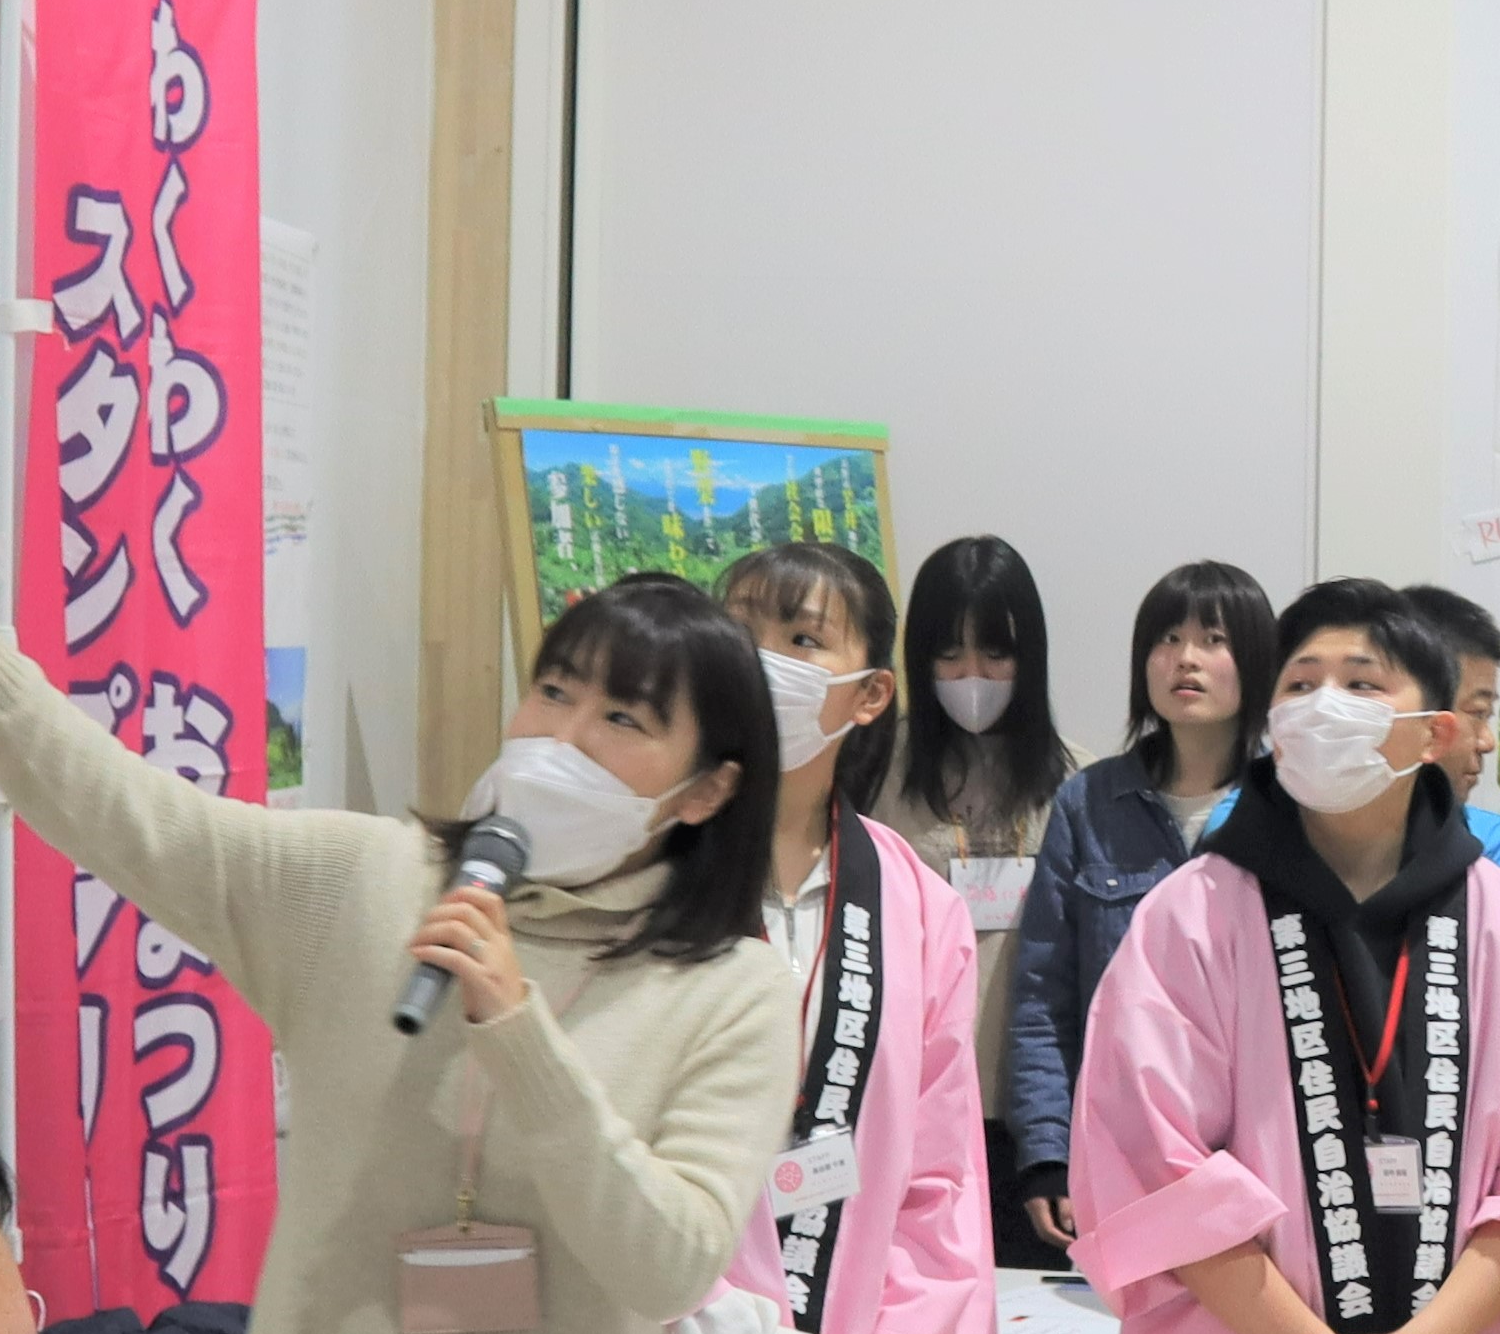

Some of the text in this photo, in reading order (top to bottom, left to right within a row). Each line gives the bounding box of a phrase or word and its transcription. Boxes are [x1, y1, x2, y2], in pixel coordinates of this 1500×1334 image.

[1270, 912, 1374, 1319] 第三地区住民自治協議会
